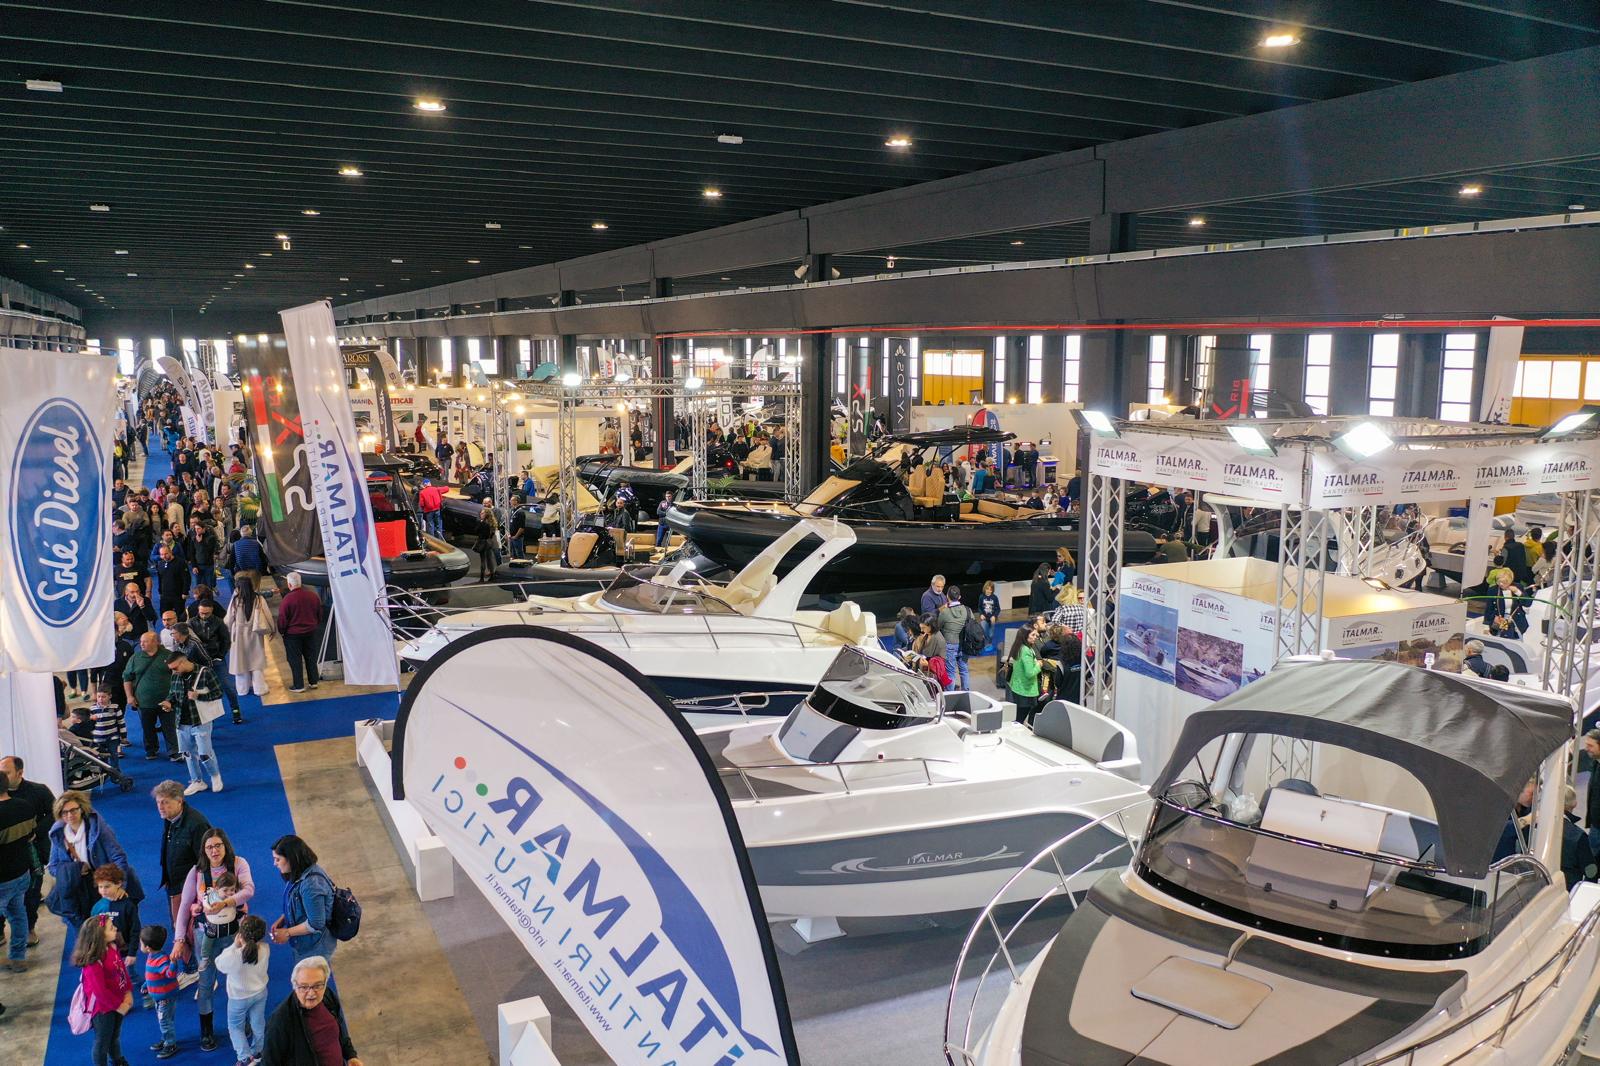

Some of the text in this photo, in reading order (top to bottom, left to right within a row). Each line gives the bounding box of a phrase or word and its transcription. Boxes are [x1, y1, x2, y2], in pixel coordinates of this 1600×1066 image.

[34, 425, 80, 603] Solé Diesel
[906, 851, 964, 865] ITALMAR
